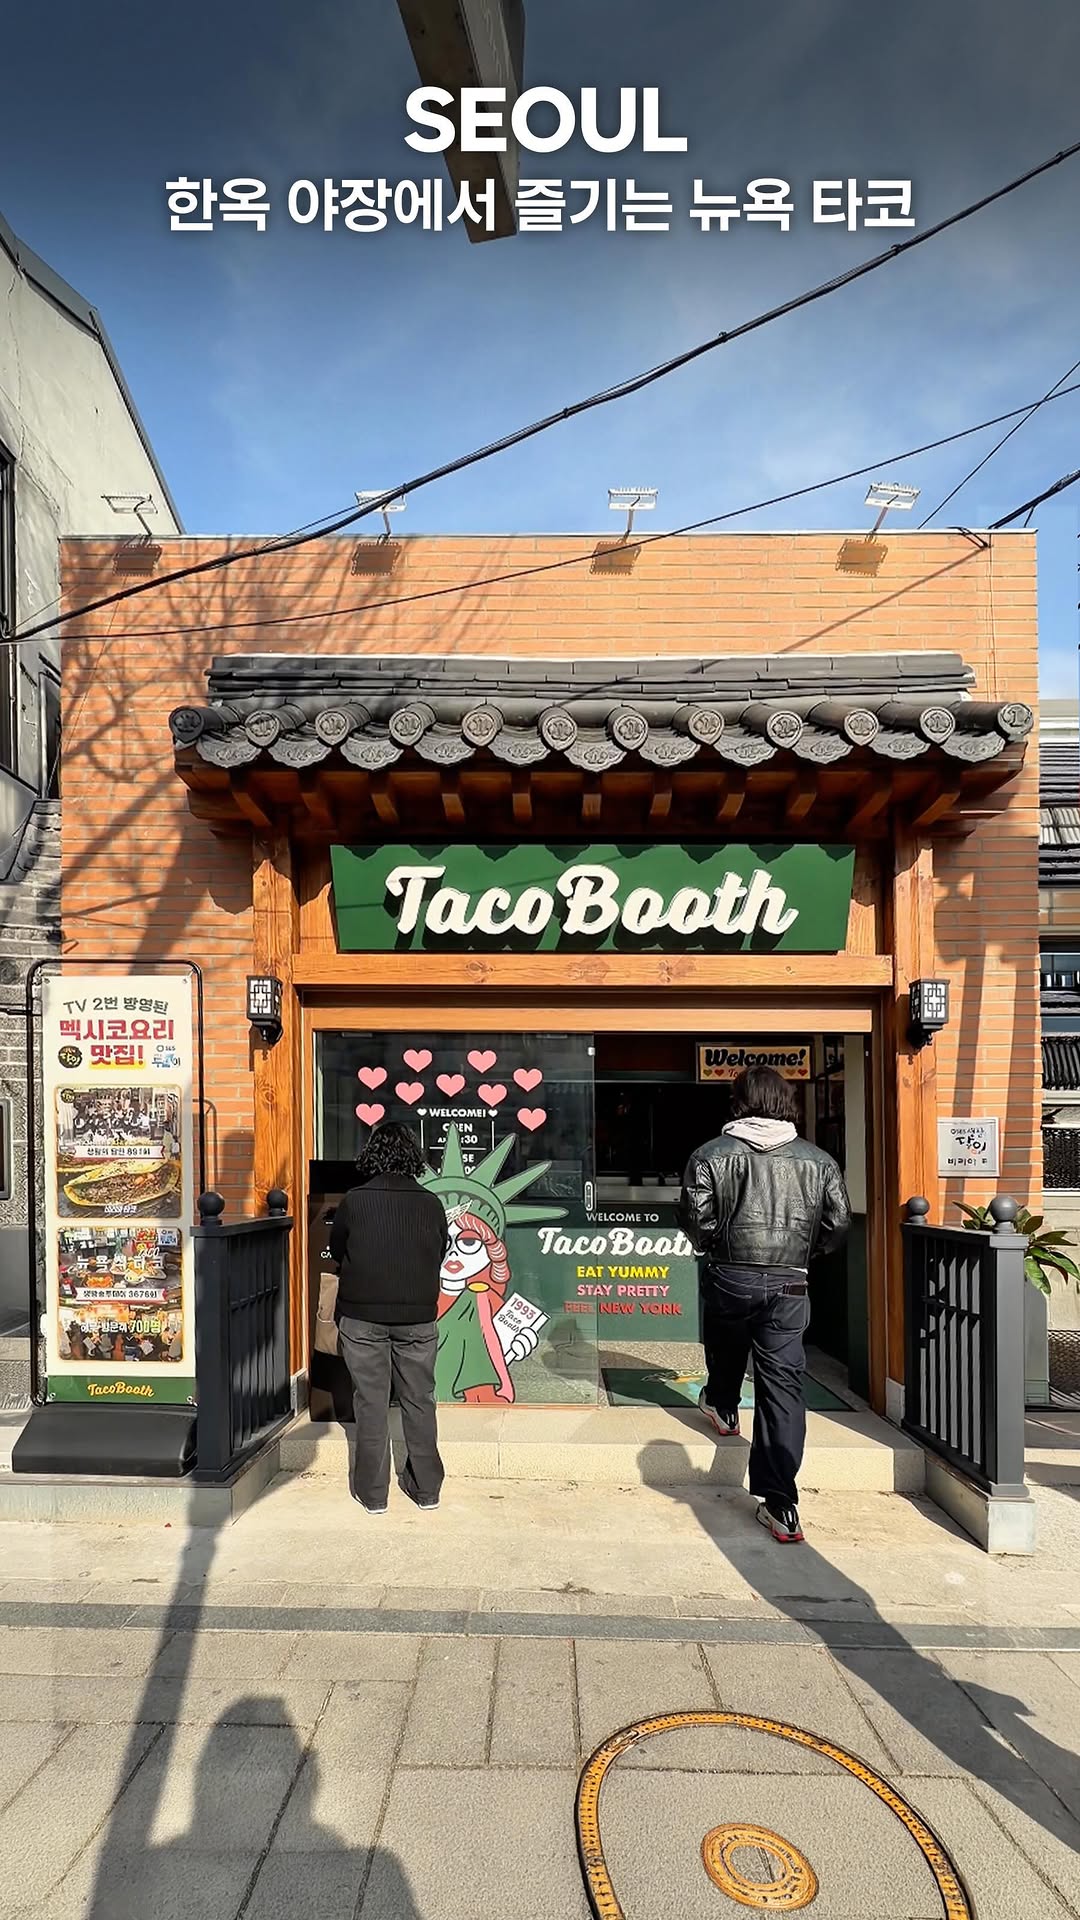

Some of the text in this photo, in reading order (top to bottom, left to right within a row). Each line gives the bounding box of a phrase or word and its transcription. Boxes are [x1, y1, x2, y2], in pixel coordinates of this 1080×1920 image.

[63, 997, 168, 1015] TV 2번 방영된
[60, 1019, 174, 1041] 멕시코요리
[91, 1045, 144, 1065] 맛집!
[705, 1048, 806, 1067] Welcome!
[429, 1108, 486, 1118] WELCOME!
[586, 1213, 660, 1222] WELCOME TO
[576, 1265, 670, 1278] EAT YUMMY
[577, 1285, 670, 1297] STAY PRETTY
[564, 1301, 682, 1315] FEEL NEW YORK
